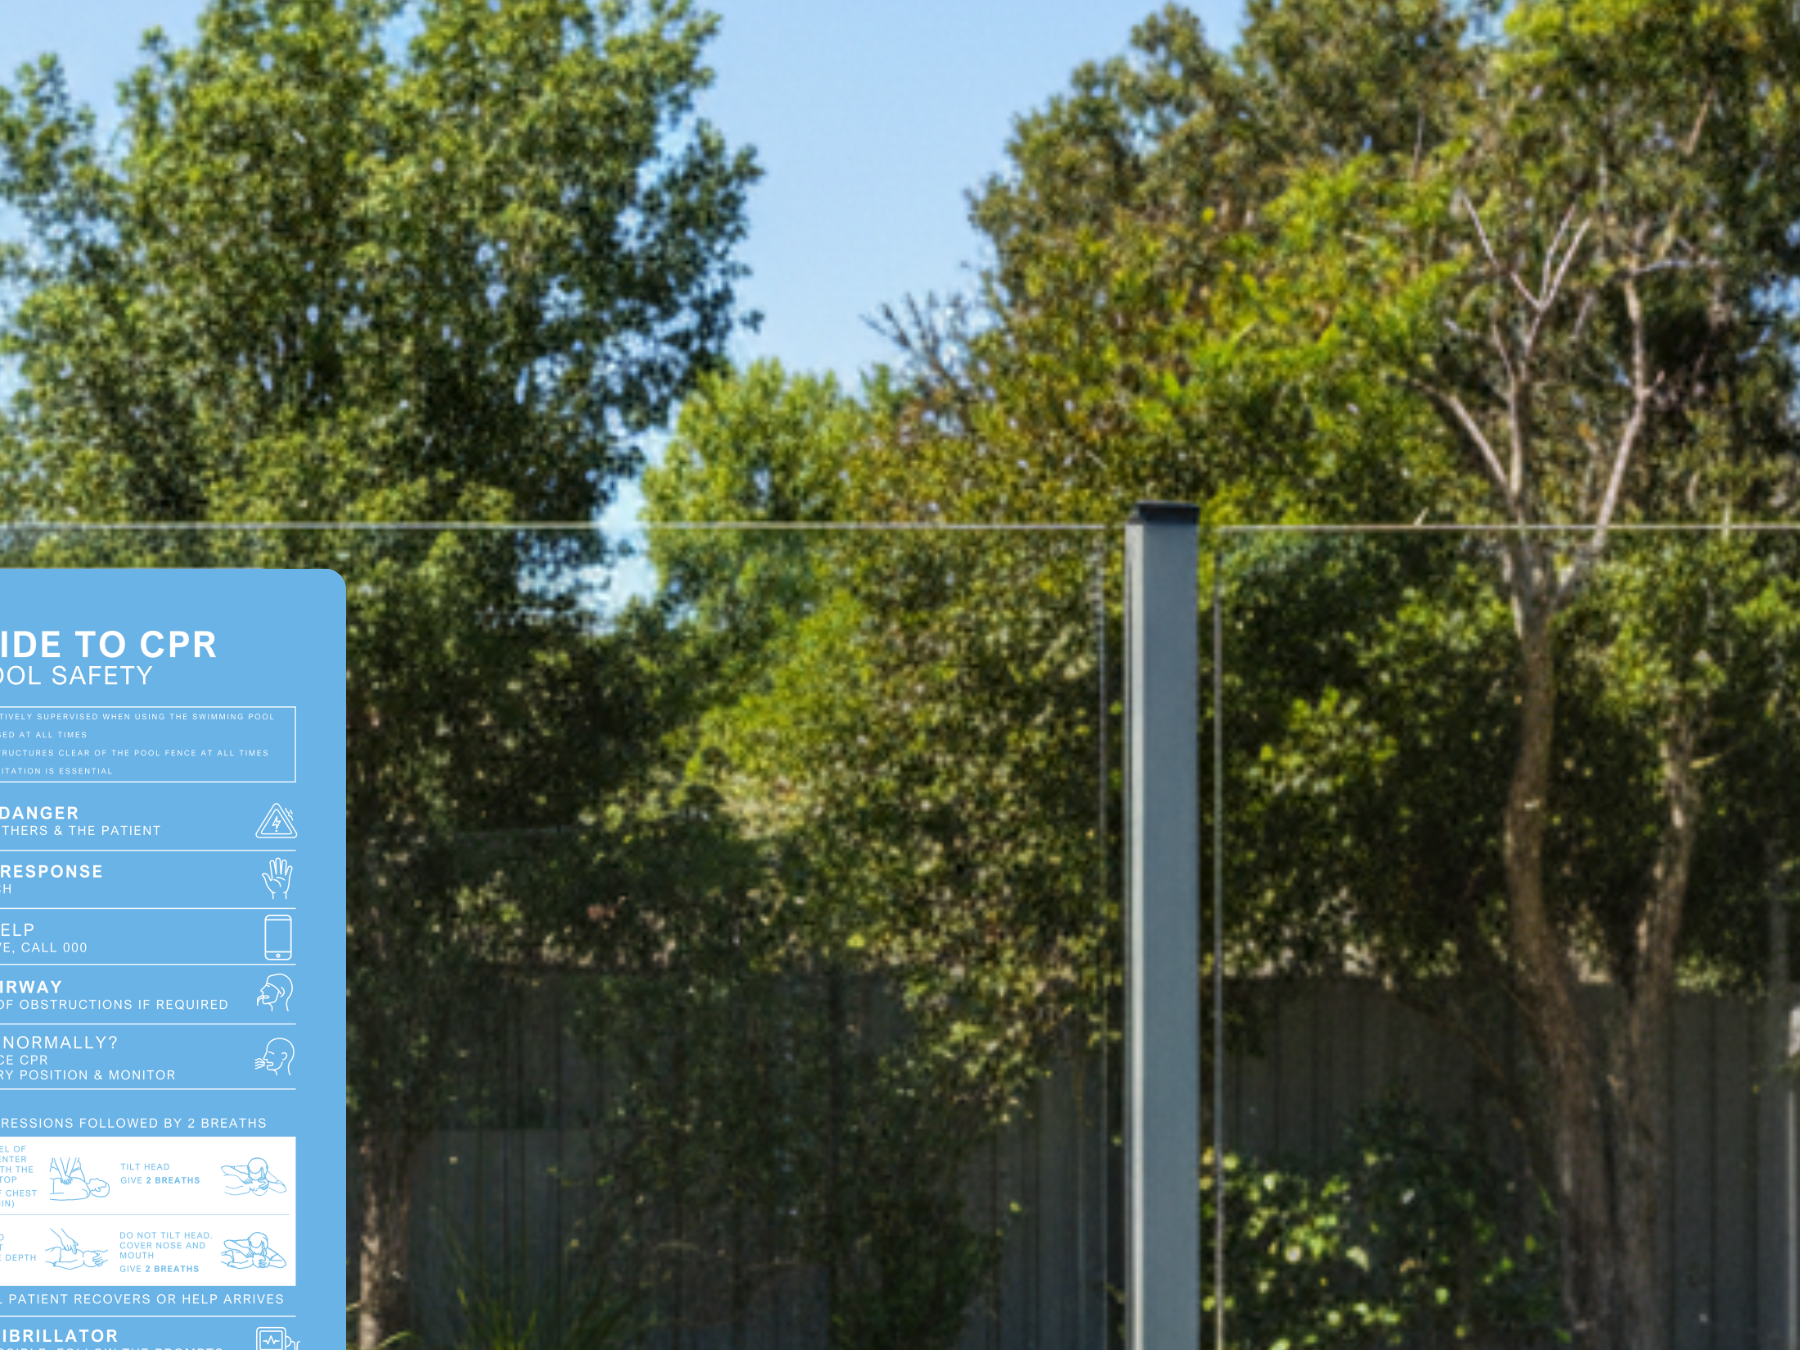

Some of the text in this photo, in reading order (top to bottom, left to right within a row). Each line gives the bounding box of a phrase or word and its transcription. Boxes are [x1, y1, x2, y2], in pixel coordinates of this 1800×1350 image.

[74, 630, 126, 658] TO
[140, 630, 216, 658] CPR
[52, 665, 153, 685] SAFETY
[54, 825, 63, 836] &
[68, 825, 95, 836] THE
[101, 825, 161, 836] PATIENT
[0, 864, 102, 878] RESPONSE
[21, 942, 57, 953] CALL
[63, 942, 87, 953] 000
[19, 999, 132, 1010] OBSTRUCTIONS
[138, 999, 150, 1010] IF
[156, 999, 228, 1010] REQUIRED
[3, 1035, 117, 1049] NORMALLY?
[19, 1054, 48, 1065] CPR
[20, 1069, 88, 1080] POSITION
[94, 1069, 103, 1080] &
[109, 1069, 175, 1080] MONITOR
[79, 1118, 158, 1129] FOLLOWED
[164, 1118, 182, 1128] BY
[187, 1118, 195, 1128] 2
[201, 1118, 266, 1129] BREATHS
[13, 1145, 26, 1153] OF
[121, 1163, 170, 1171] TILT HEAD
[120, 1176, 200, 1184] GIVE 2 BREATHS
[5, 1189, 37, 1197] CHEST
[9, 1294, 68, 1304] PATIENT
[74, 1293, 150, 1304] RECOVERS
[156, 1293, 176, 1304] OR
[182, 1294, 218, 1304] HELP
[223, 1293, 284, 1304] ARRIVES
